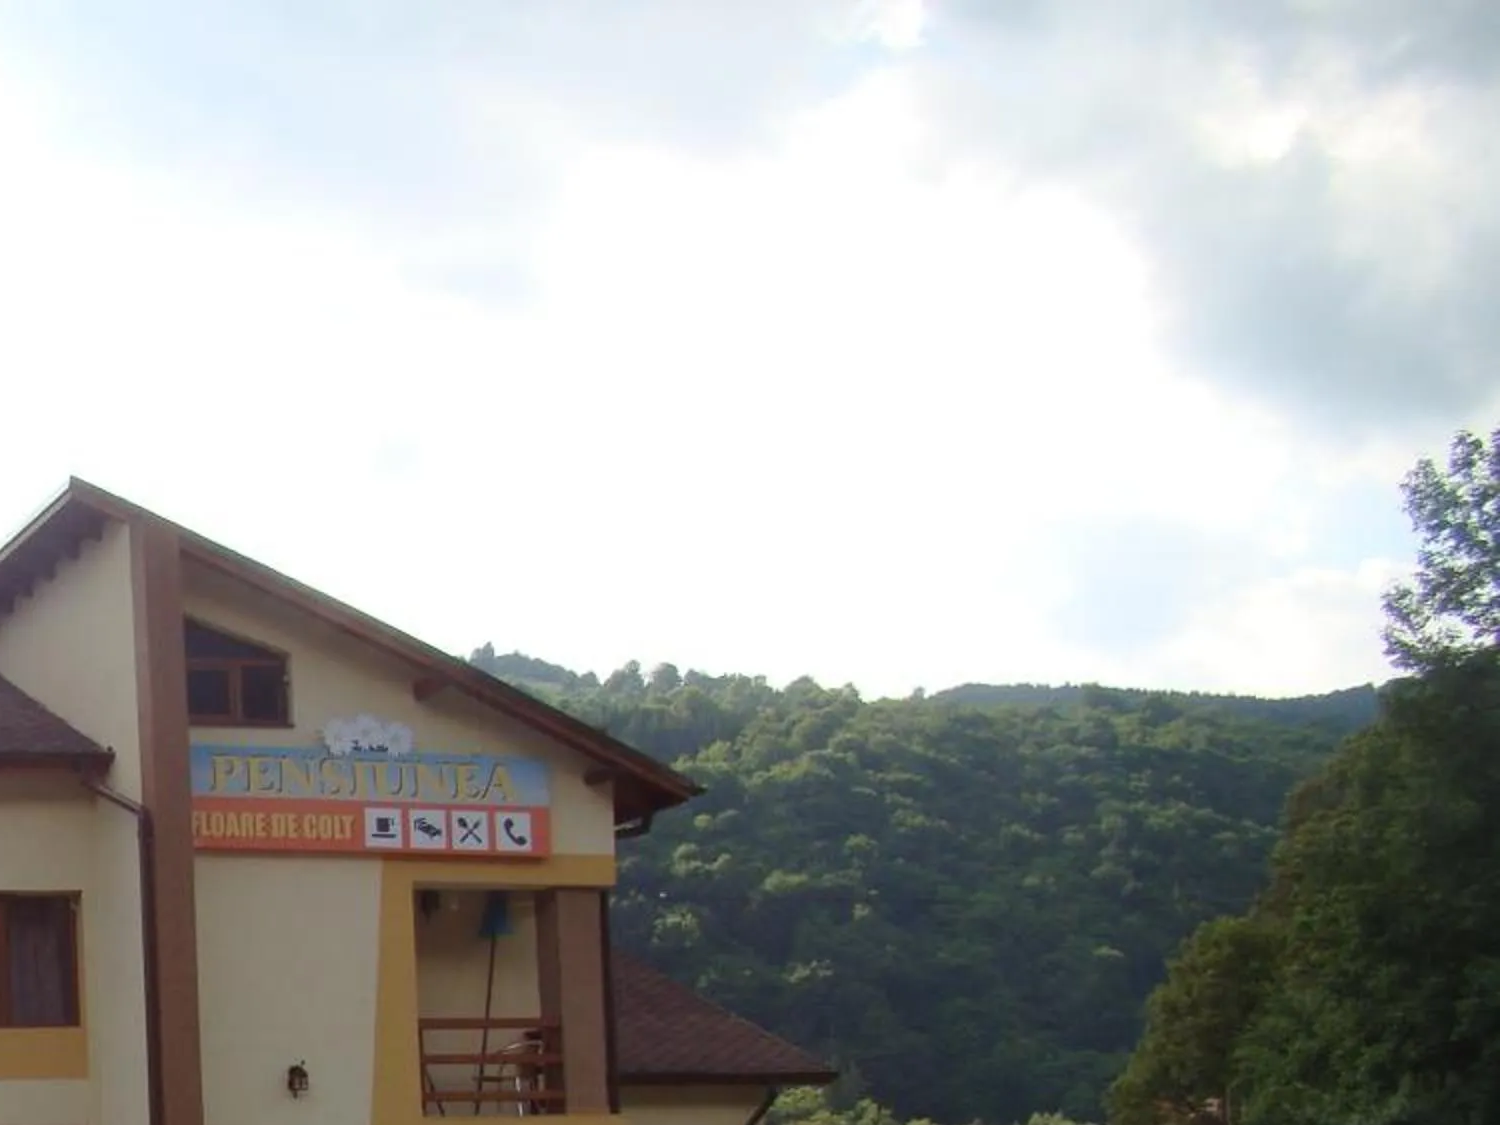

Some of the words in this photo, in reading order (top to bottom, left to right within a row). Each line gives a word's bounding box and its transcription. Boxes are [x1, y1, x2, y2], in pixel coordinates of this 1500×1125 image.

[212, 754, 516, 801] PENSIUNEA
[192, 811, 267, 837] FLOARE
[271, 813, 300, 837] DE
